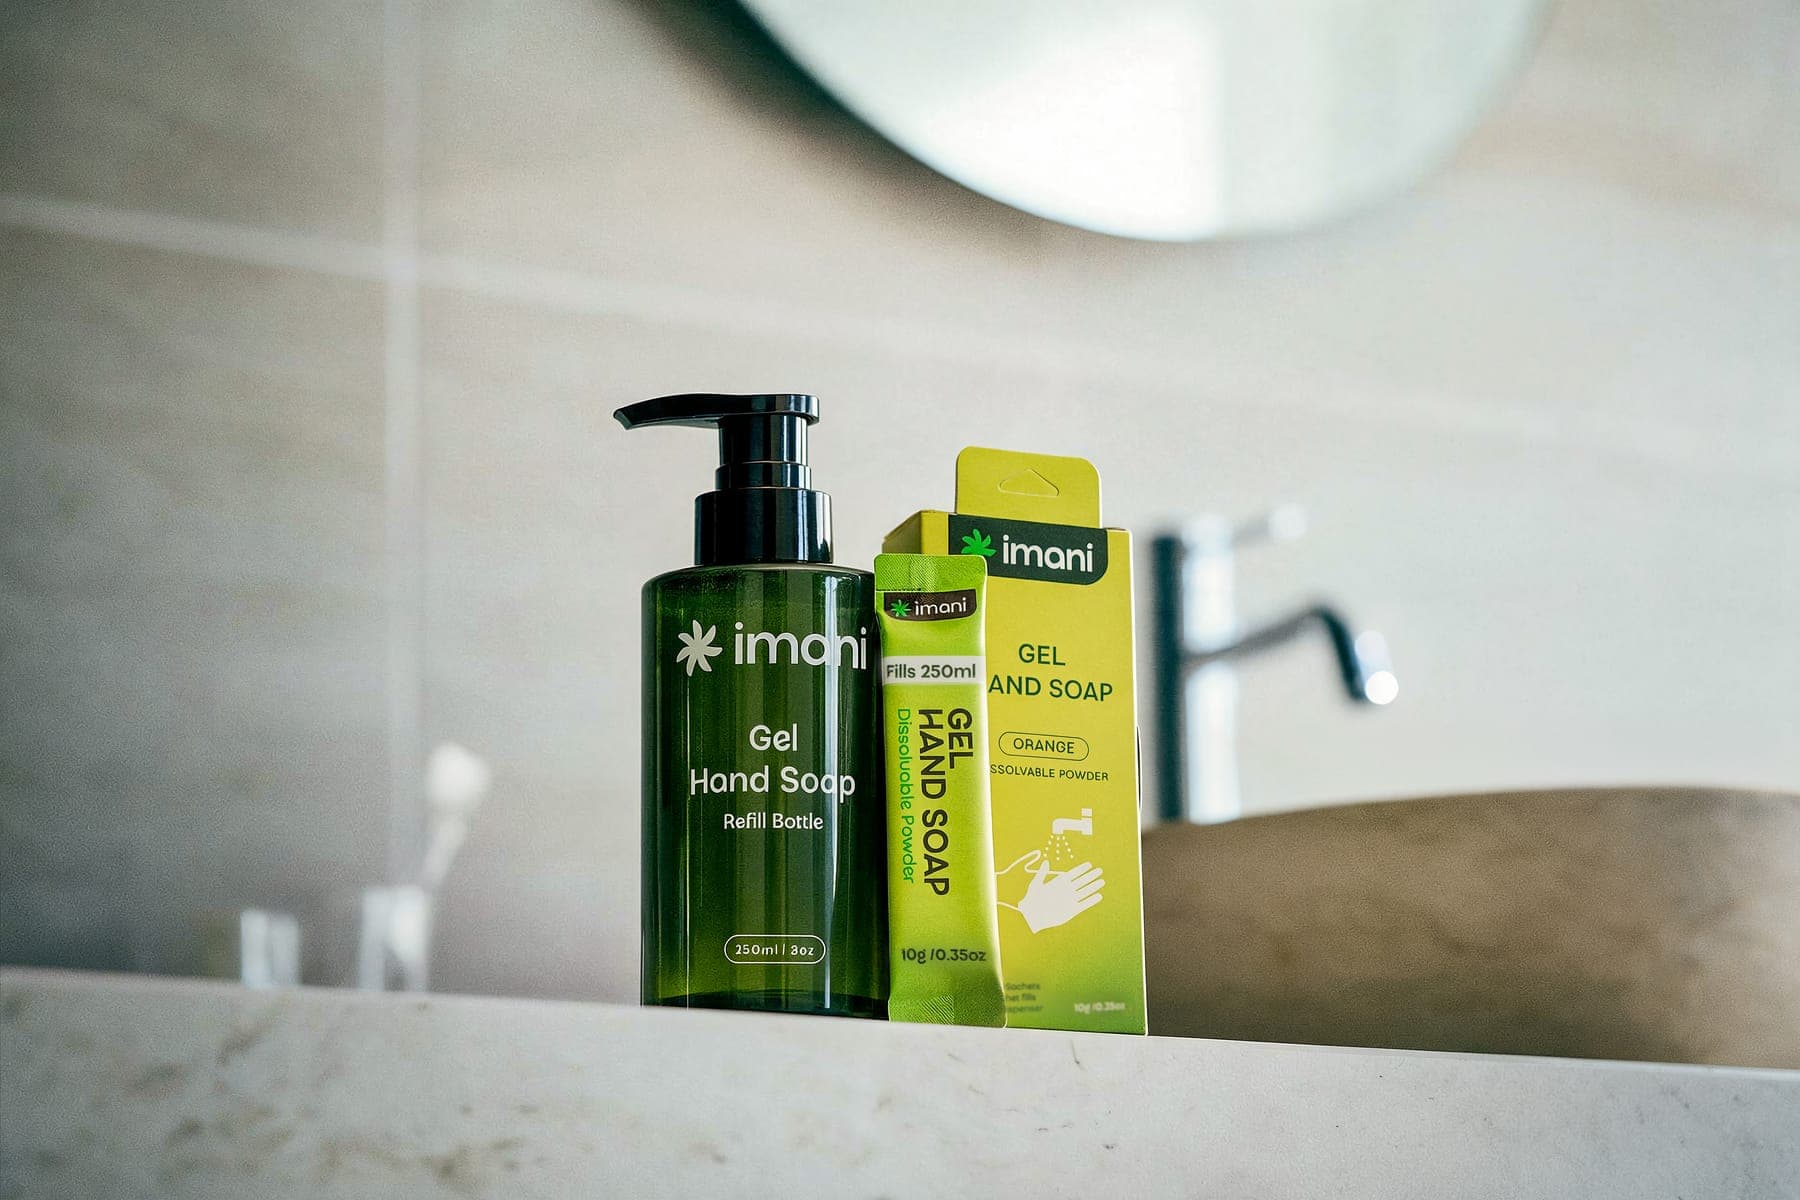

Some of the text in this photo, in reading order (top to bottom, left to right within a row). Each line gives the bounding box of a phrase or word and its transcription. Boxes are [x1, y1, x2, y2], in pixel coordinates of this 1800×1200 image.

[1002, 534, 1094, 573] imani
[915, 597, 967, 616] imani
[734, 621, 868, 670] imani
[1018, 643, 1066, 666] GEL
[886, 664, 976, 679] Fills 250ml
[987, 674, 1113, 701] AND SOAP
[749, 723, 799, 752] Gel
[947, 707, 974, 769] GEL
[1013, 737, 1075, 754] ORANGE
[690, 764, 857, 804] Hand Soap
[990, 764, 1109, 781] SSOLVABLE POWDER
[918, 709, 950, 896] HAND SOAP
[723, 812, 825, 831] Refill Bottle
[901, 815, 918, 884] Powder
[735, 943, 778, 956] 250ml
[901, 948, 926, 964] 10g
